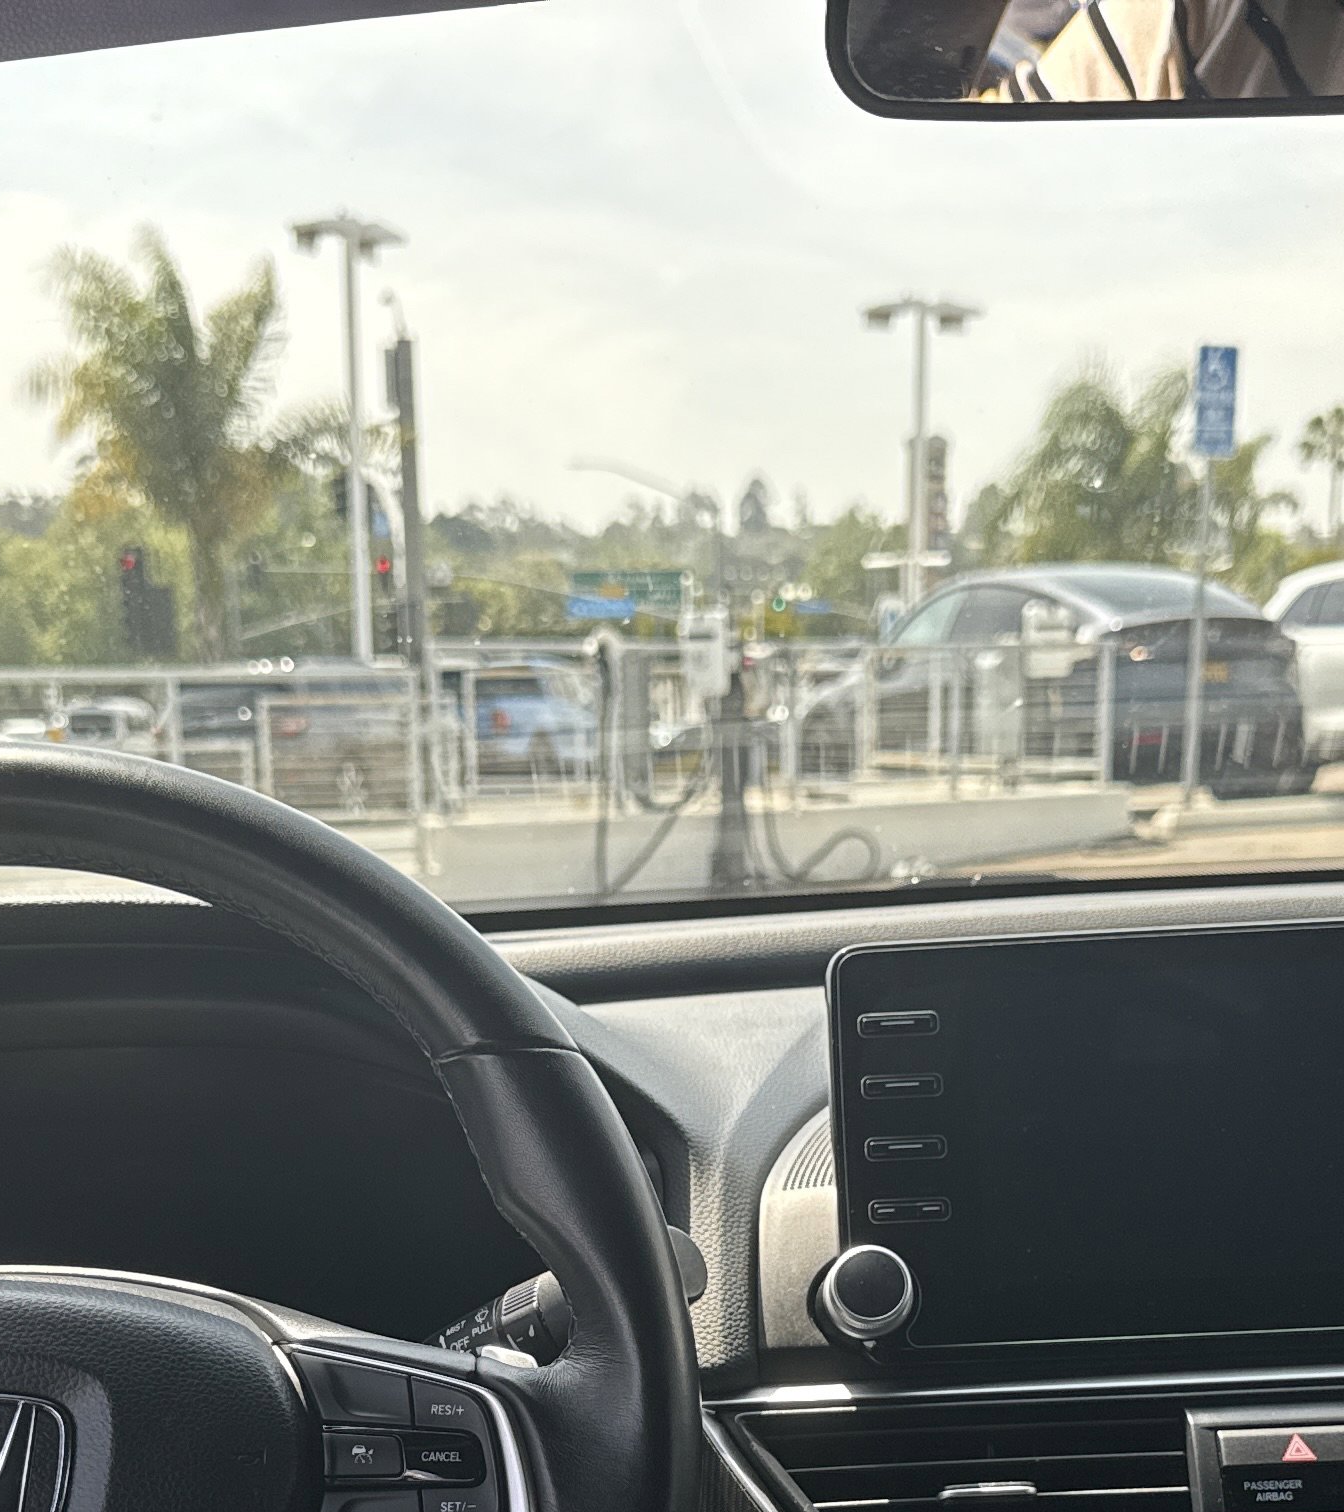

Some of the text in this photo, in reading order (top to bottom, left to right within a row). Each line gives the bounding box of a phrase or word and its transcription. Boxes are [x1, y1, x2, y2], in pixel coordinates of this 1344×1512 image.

[446, 1320, 467, 1337] MIST
[471, 1322, 493, 1338] PULL
[449, 1335, 470, 1351] OFF
[421, 1450, 463, 1463] CANCEL
[1243, 1480, 1303, 1491] PASSENGER
[1256, 1491, 1294, 1501] AIRBAG
